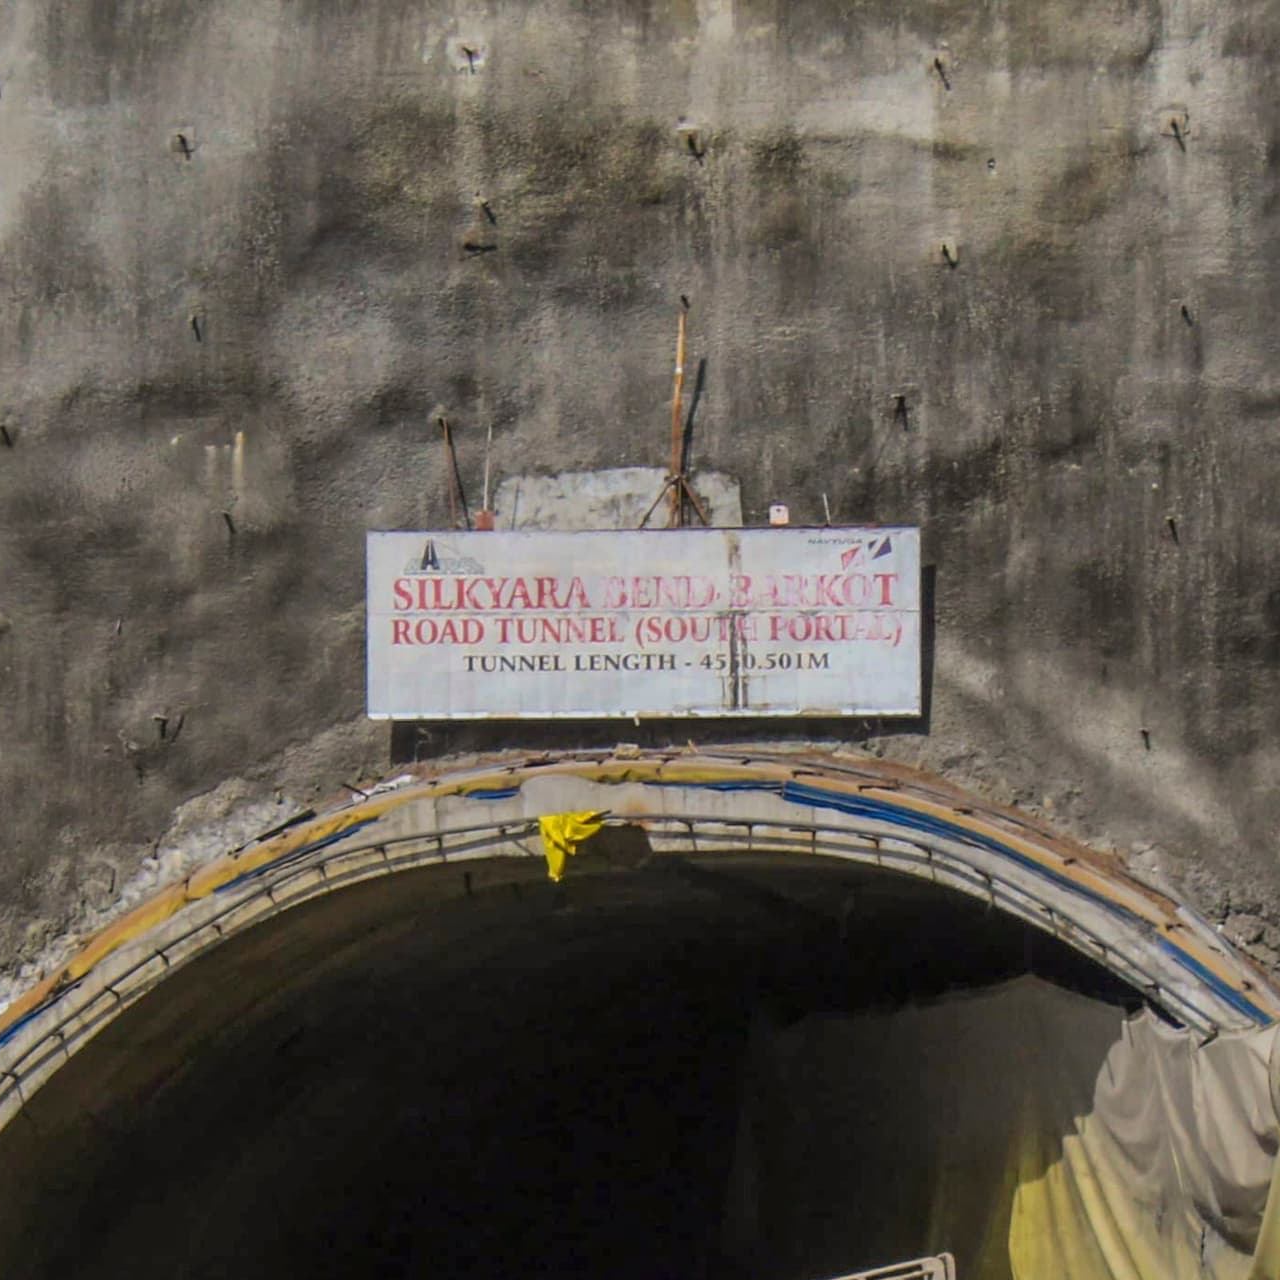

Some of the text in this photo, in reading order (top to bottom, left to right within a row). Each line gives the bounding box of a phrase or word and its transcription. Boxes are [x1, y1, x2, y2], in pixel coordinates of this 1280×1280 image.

[393, 576, 591, 611] SILKYARA
[392, 612, 903, 650] ROAD TUNNEL (SOUTH PORTAL)
[463, 654, 567, 673] TUNNEL
[573, 653, 677, 672] LENGTH
